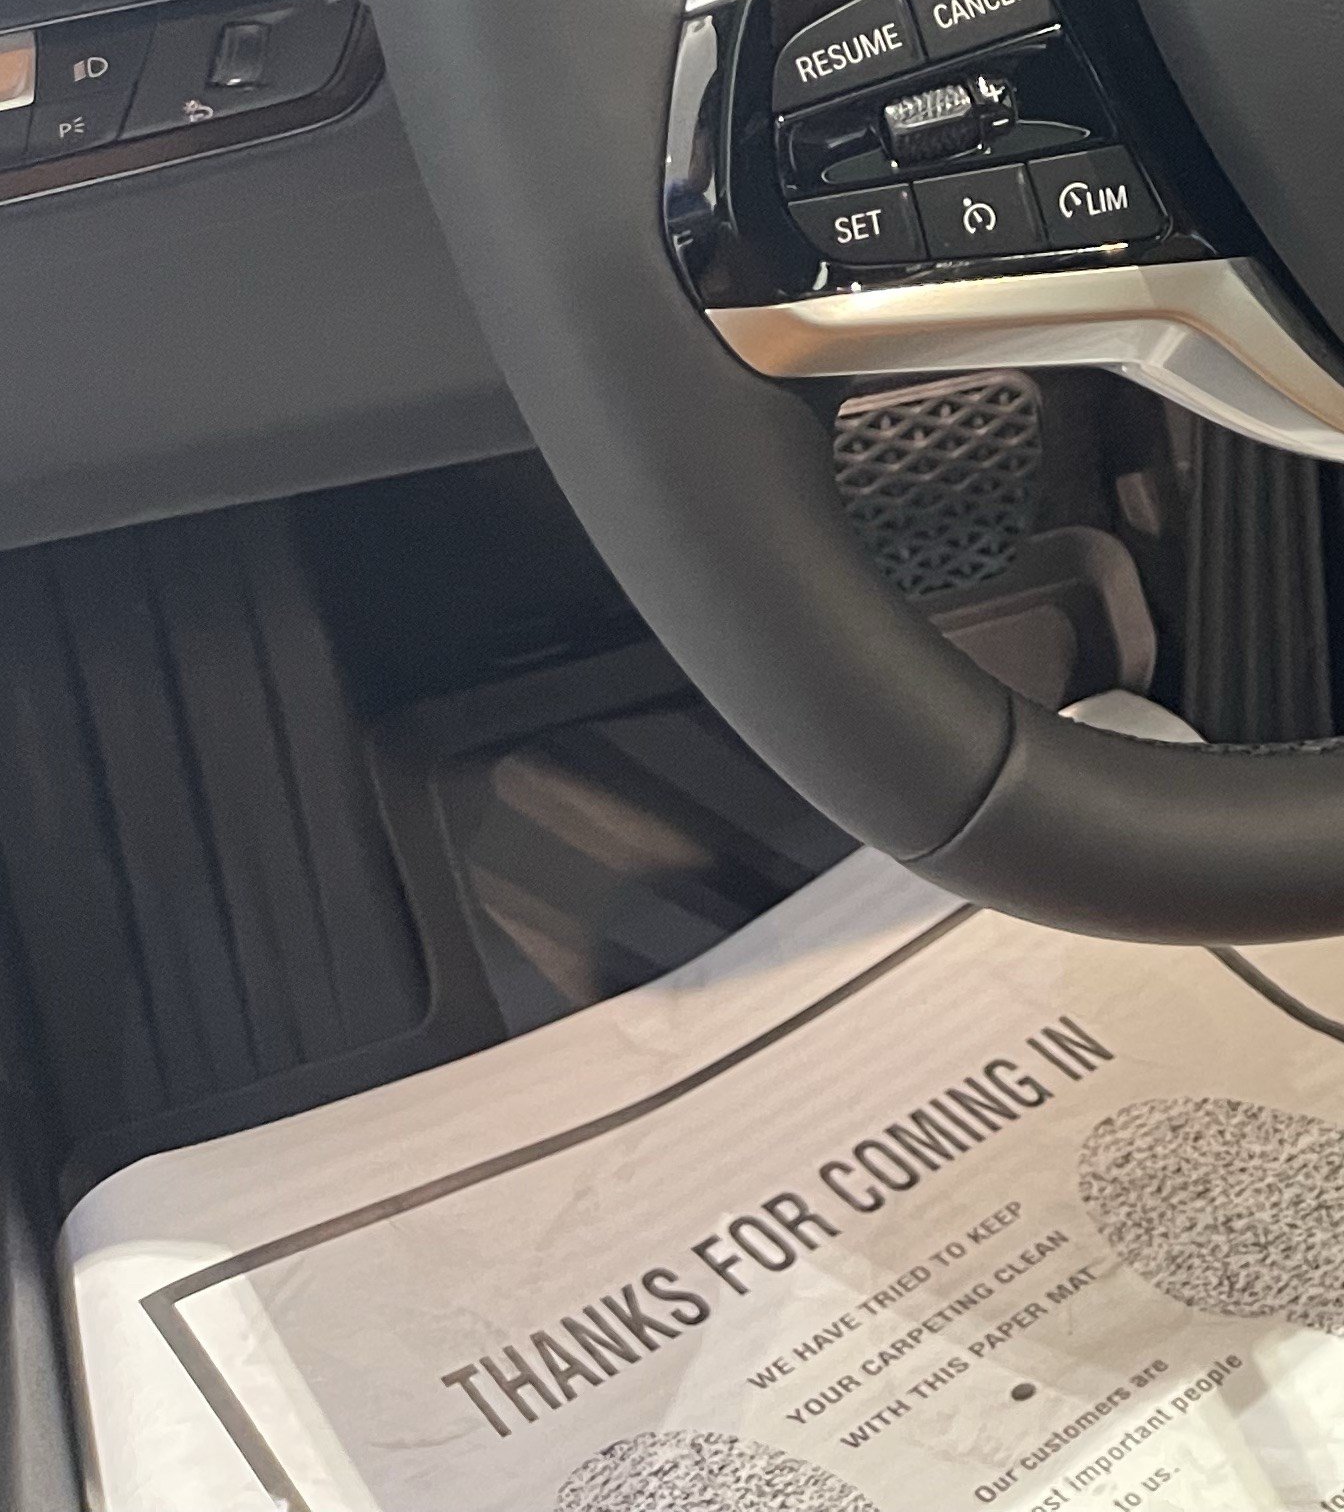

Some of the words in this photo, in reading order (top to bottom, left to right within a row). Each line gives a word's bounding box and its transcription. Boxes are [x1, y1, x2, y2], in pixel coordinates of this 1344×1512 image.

[795, 22, 903, 83] RESUME
[834, 209, 882, 244] SET
[1087, 185, 1128, 216] LIM
[440, 1267, 711, 1438] THANKS
[691, 1192, 843, 1296] FOR
[818, 1058, 1055, 1213] COMING
[1025, 1015, 1115, 1081] IN
[747, 1355, 796, 1389] WE
[792, 1312, 863, 1362] HAVE
[855, 1265, 932, 1316] TRIED
[928, 1241, 968, 1267] TO
[966, 1200, 1022, 1245] KEEP
[785, 1374, 863, 1425] YOUR
[860, 1282, 995, 1376] CARPETING
[993, 1230, 1069, 1285] CLEAN
[840, 1399, 912, 1449] WITH
[906, 1356, 969, 1399] THIS
[967, 1302, 1049, 1358] PAPER
[1044, 1265, 1098, 1304] MAT
[974, 1468, 1019, 1503] Our
[1020, 1387, 1131, 1472] customers
[1129, 1358, 1169, 1388] are
[1063, 1407, 1174, 1492] important
[1170, 1353, 1243, 1415] people
[1113, 1492, 1142, 1512] to
[1141, 1467, 1180, 1492] us.
